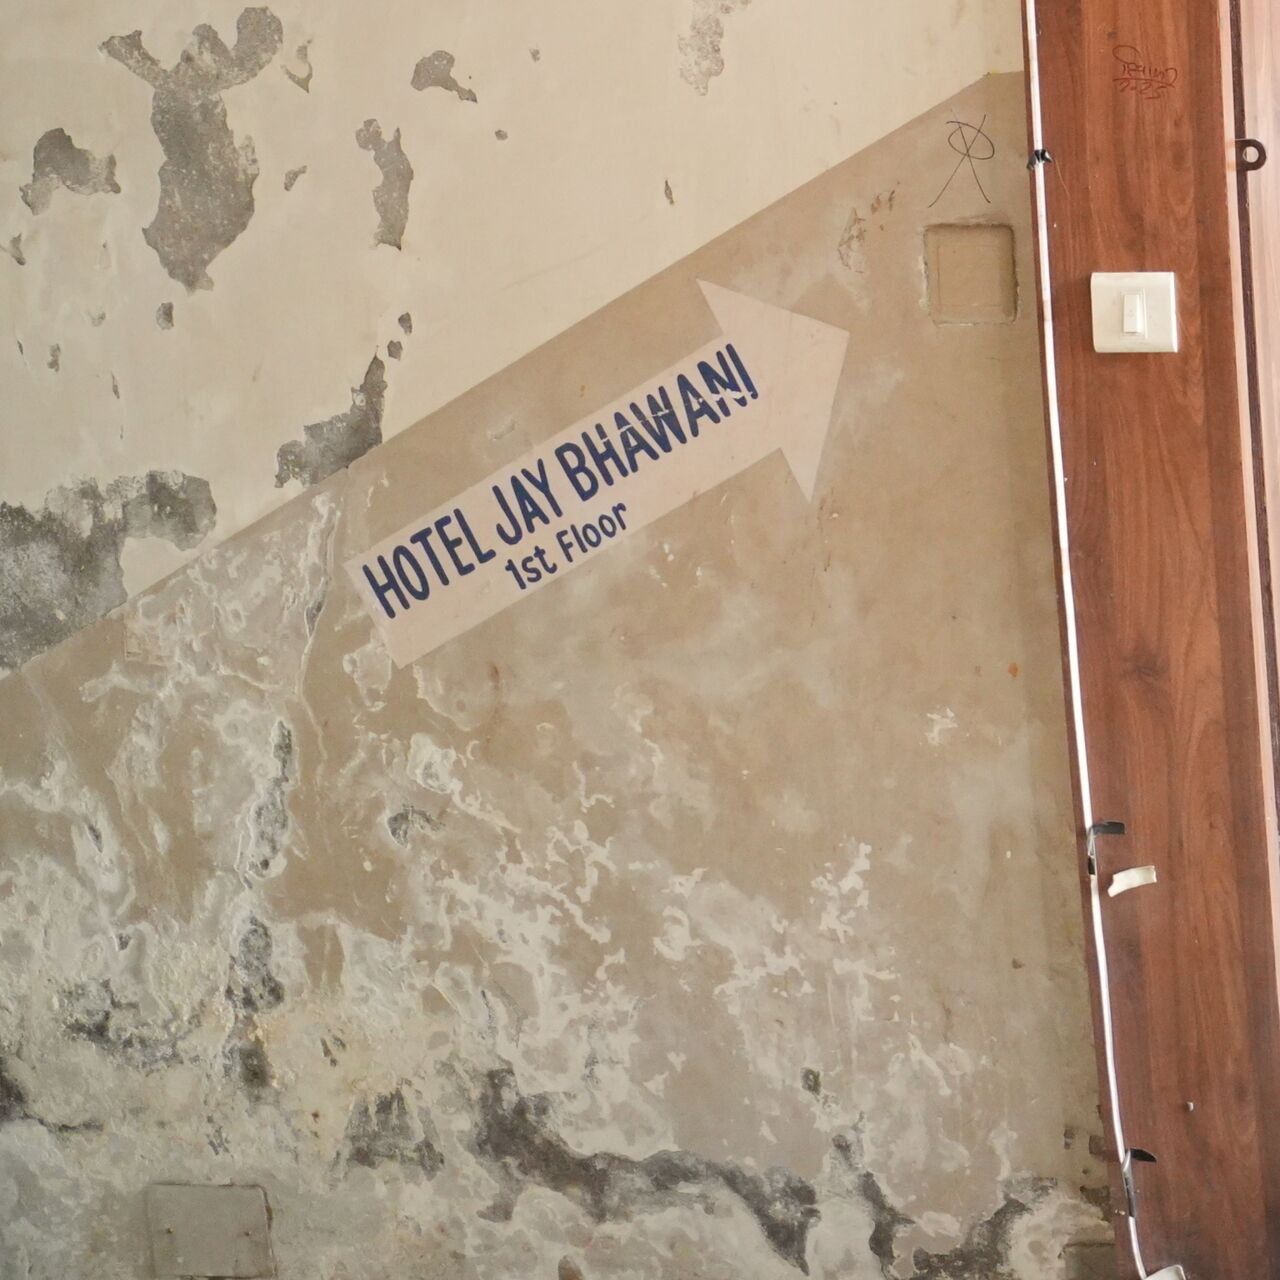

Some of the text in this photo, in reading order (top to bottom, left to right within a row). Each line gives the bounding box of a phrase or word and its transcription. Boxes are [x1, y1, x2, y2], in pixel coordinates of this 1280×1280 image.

[362, 343, 760, 620] HOTEL JAY BHAWANI
[504, 502, 628, 591] 1st Floor
